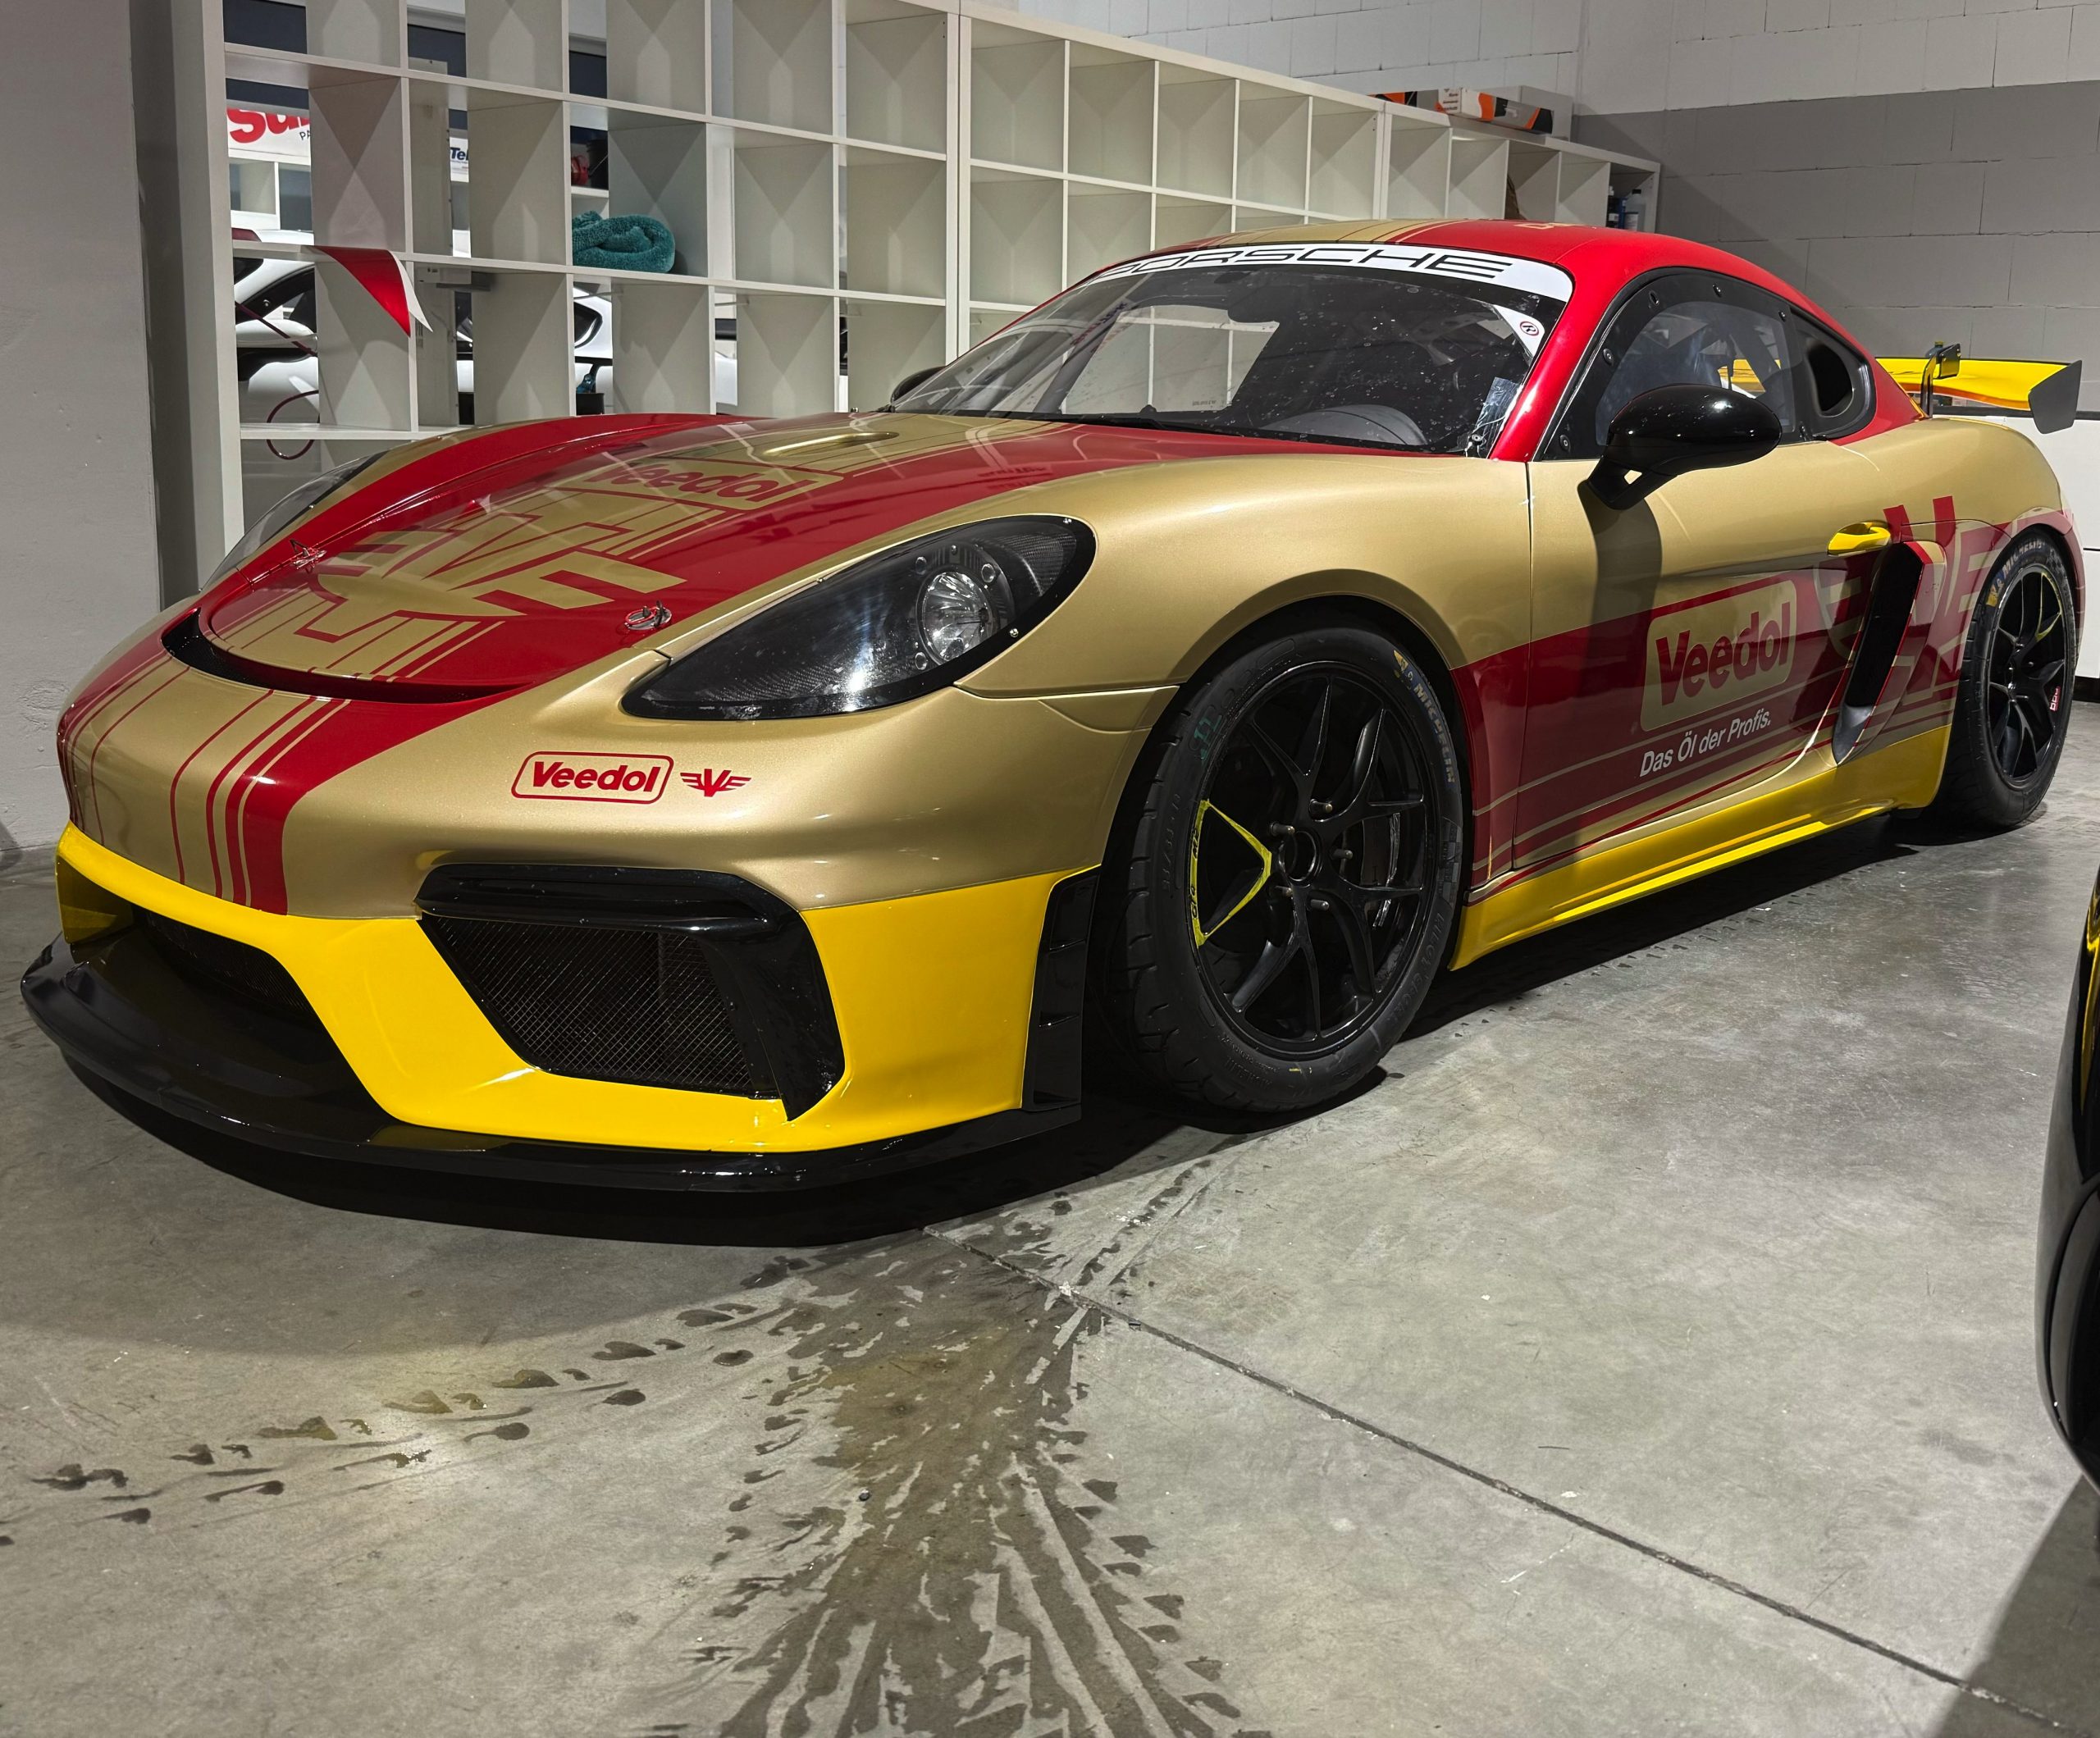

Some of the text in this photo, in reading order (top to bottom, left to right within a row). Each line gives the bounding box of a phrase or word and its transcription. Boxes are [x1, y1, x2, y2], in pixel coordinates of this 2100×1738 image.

[1086, 248, 1513, 285] PORSCHE
[583, 463, 819, 503] Veedol
[1655, 600, 1791, 706] Veedol
[1639, 708, 1772, 777] Das Öl der Profis.
[532, 761, 661, 792] Veedol
